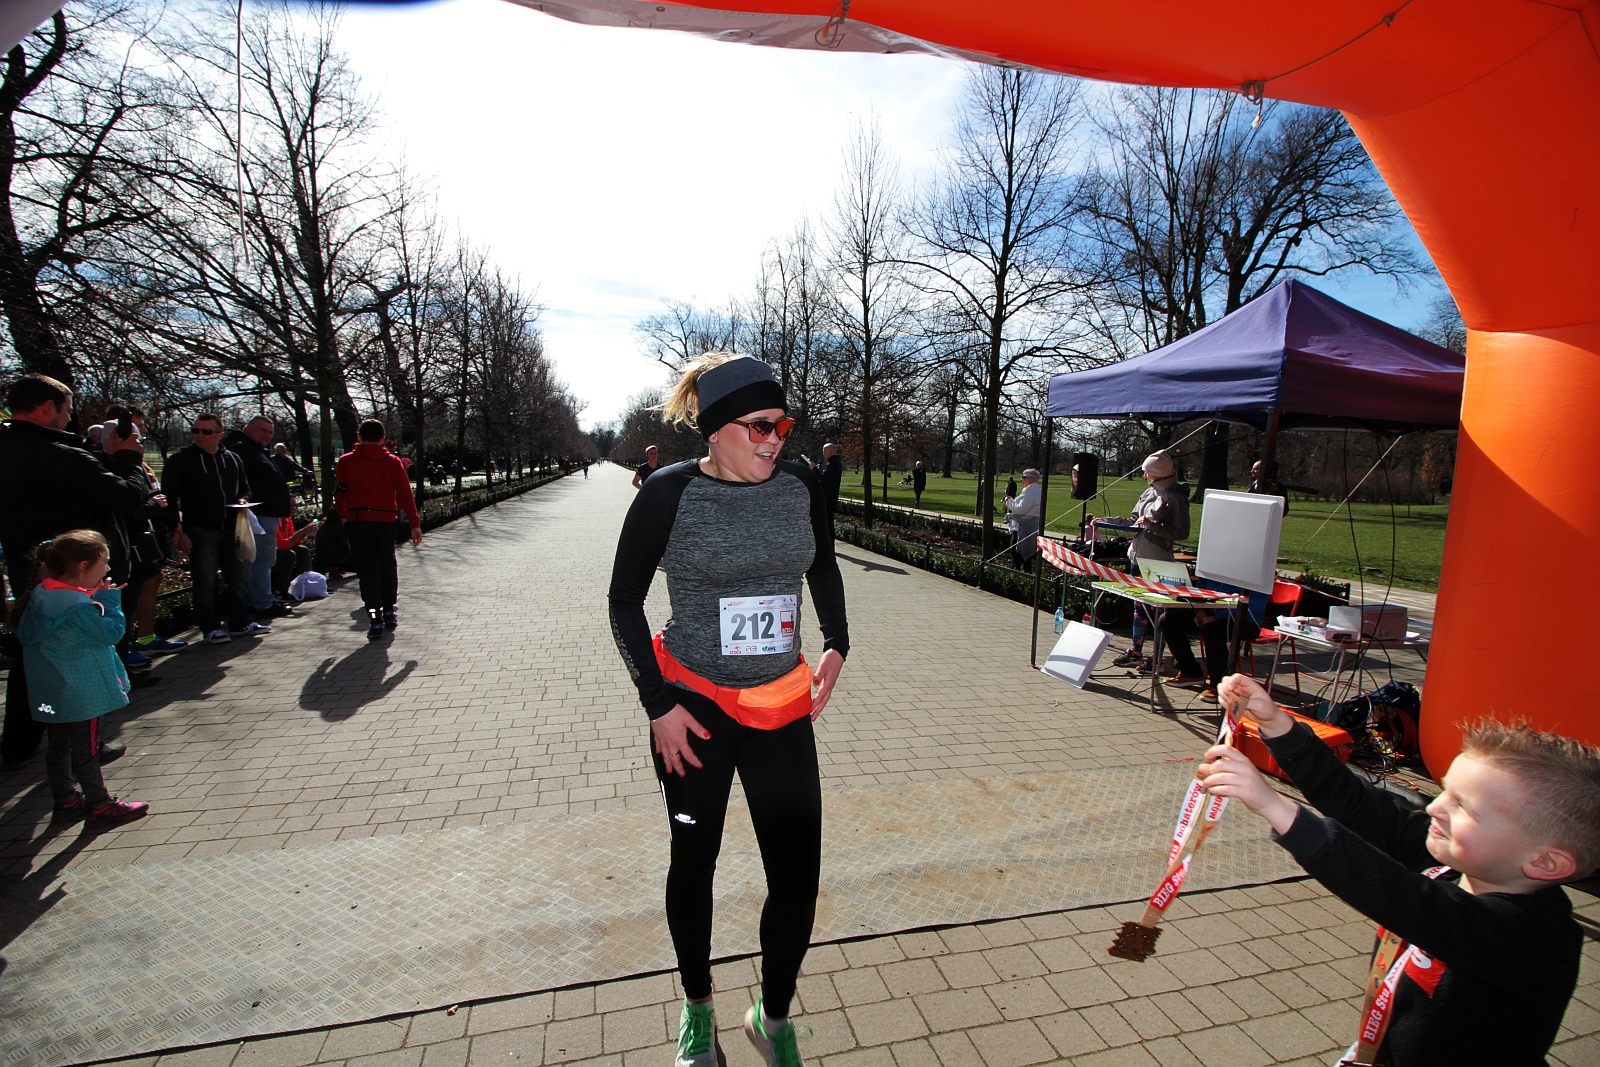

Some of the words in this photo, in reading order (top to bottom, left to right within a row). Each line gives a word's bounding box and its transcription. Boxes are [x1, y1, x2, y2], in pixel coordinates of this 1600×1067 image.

[730, 611, 775, 641] 212
[1153, 881, 1175, 909] BIEG
[1363, 1009, 1384, 1042] BIEG
[1375, 987, 1391, 1010] Stu
